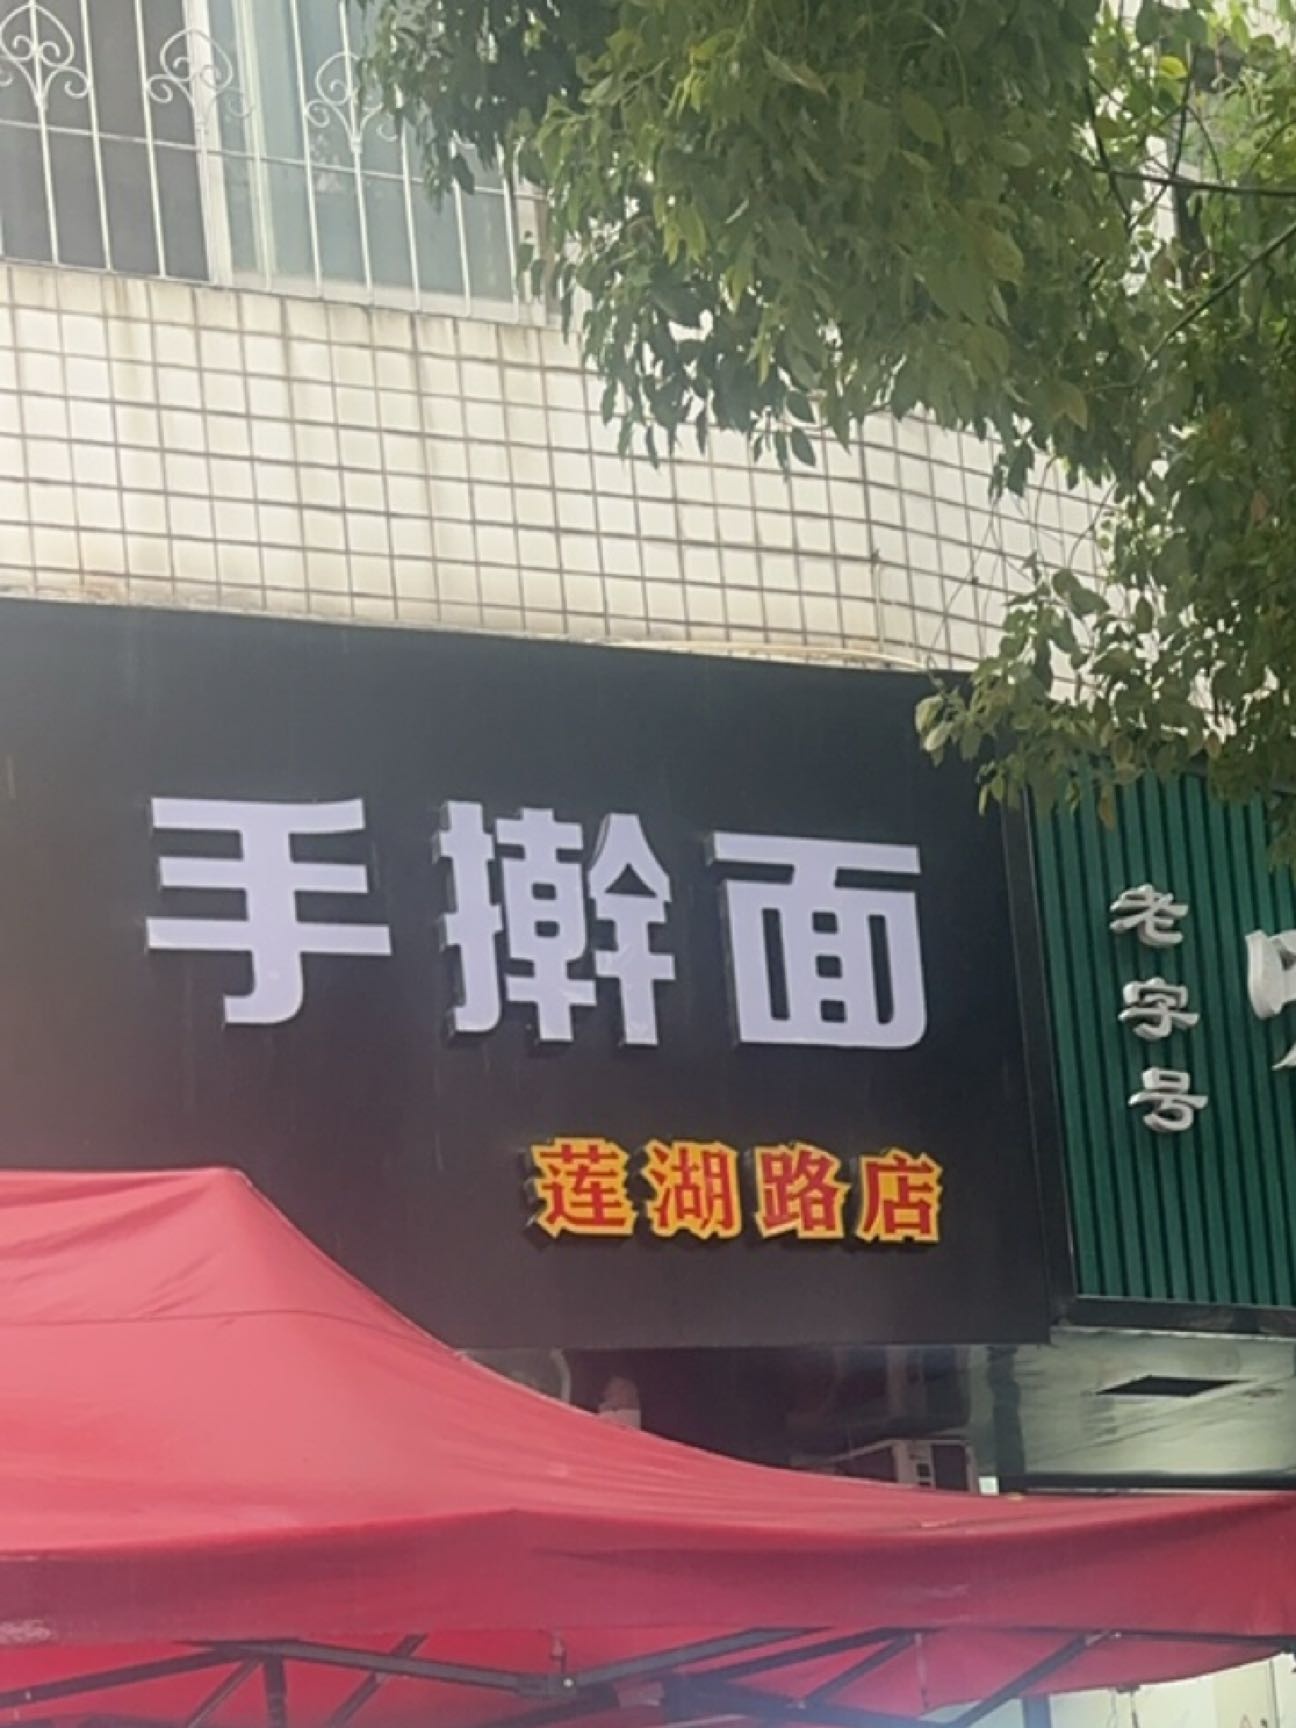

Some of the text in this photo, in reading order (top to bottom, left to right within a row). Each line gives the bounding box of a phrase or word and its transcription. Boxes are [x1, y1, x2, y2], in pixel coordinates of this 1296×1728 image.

[145, 797, 930, 1048] 手擀面
[1109, 883, 1208, 1133] 老字号
[527, 1136, 944, 1243] 莲湖路店
